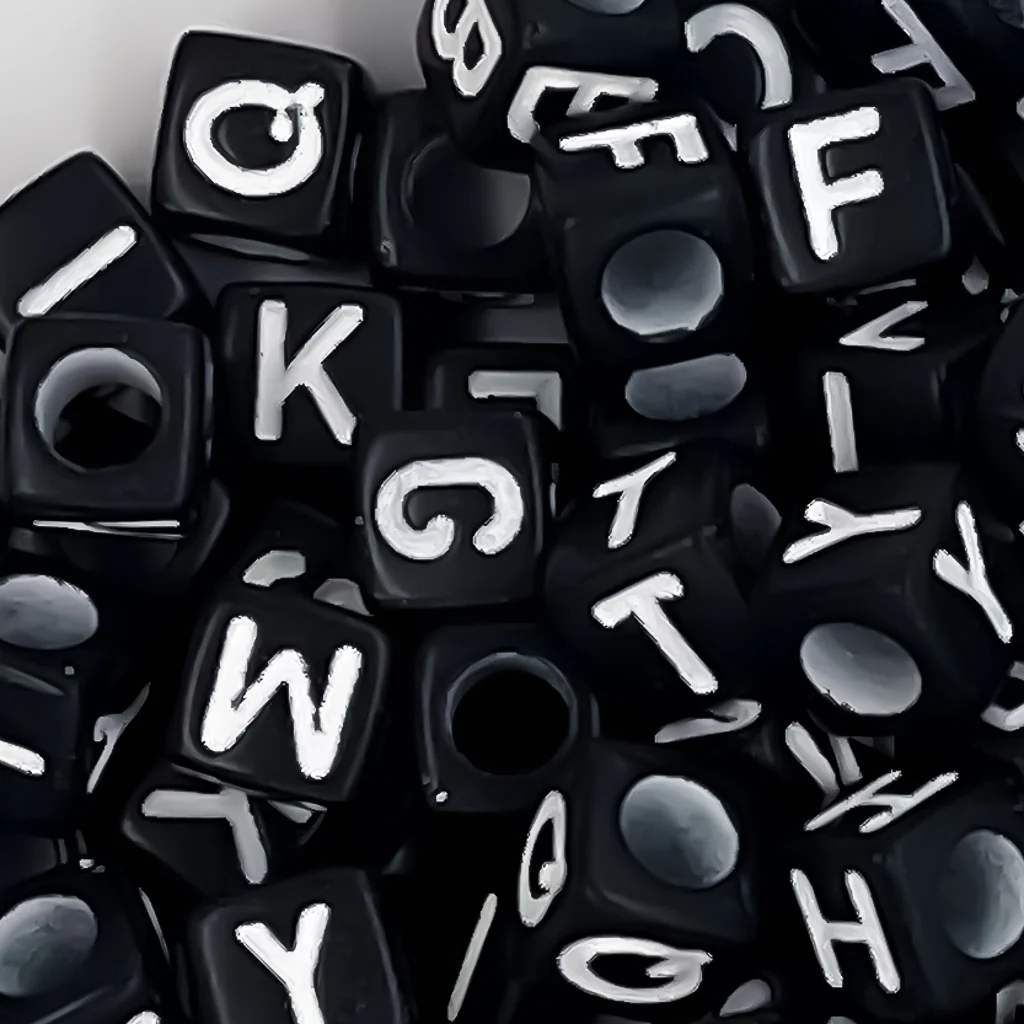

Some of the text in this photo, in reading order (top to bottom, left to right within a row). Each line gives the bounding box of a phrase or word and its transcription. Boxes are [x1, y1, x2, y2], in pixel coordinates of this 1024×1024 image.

[185, 80, 324, 196] Q
[559, 114, 708, 168] F
[788, 107, 884, 260] F
[255, 300, 363, 445] K
[375, 458, 524, 559] G
[783, 500, 921, 563] Y
[933, 503, 1013, 643] Y
[593, 574, 718, 694] T
[556, 937, 712, 1003] Q
[790, 869, 900, 993] H
